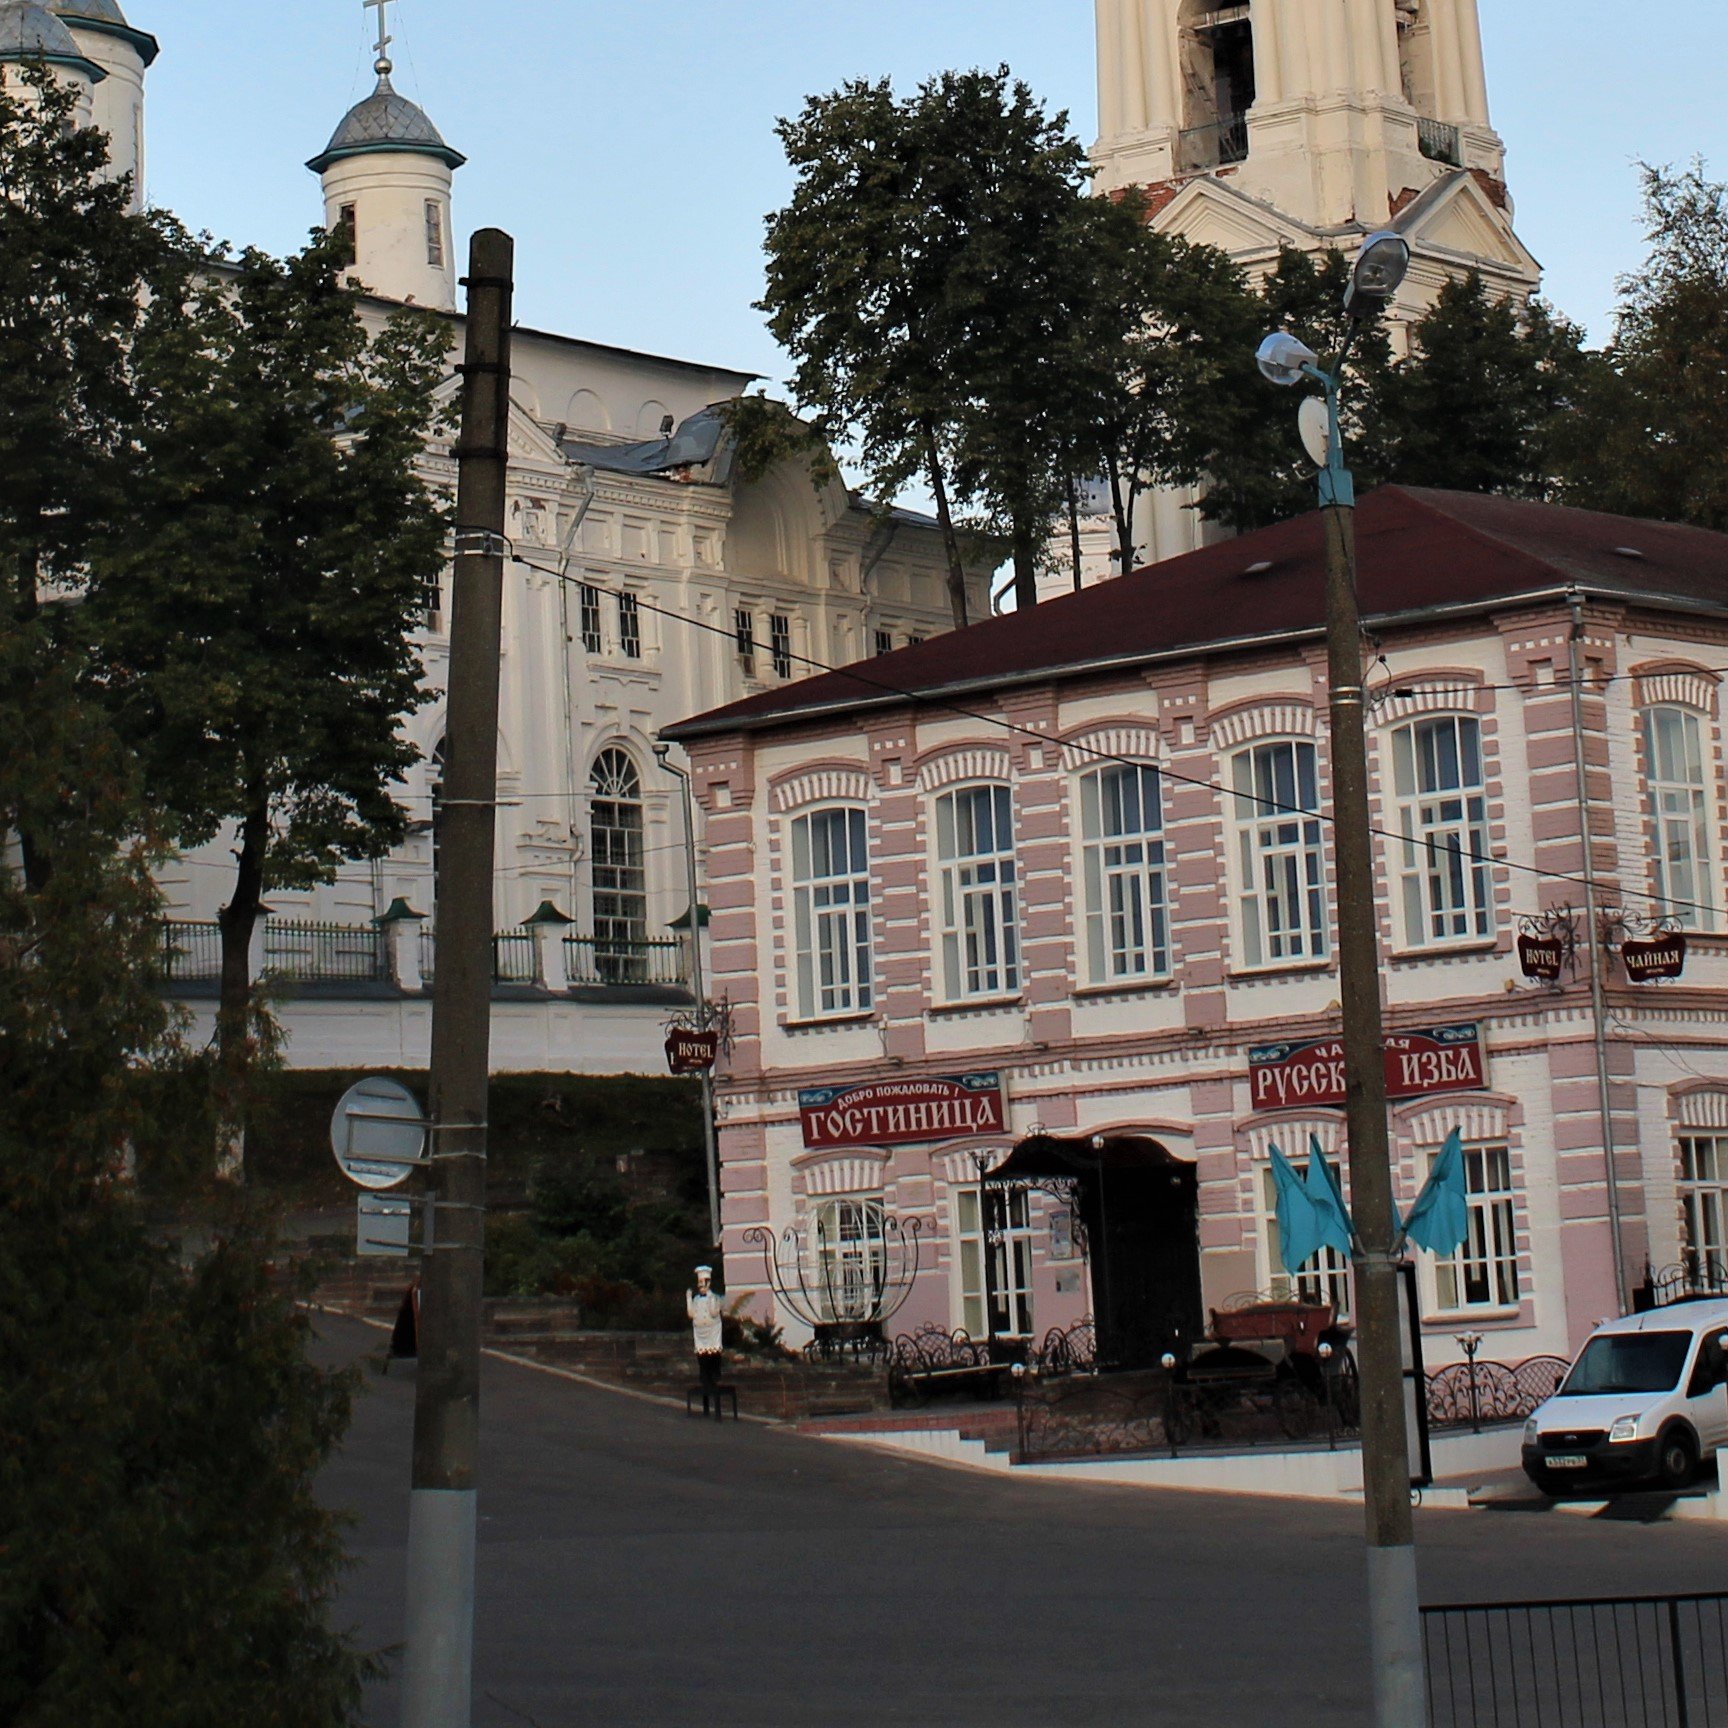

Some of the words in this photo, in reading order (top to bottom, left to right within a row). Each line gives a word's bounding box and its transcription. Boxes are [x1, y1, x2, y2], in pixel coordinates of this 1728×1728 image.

[1525, 948, 1559, 966] HOTEL
[1626, 949, 1680, 968] ЧАЙНАЯ
[678, 1042, 713, 1058] HOTEL
[1314, 1037, 1410, 1057] ЧААЯ
[1256, 1060, 1346, 1104] РУССК
[1399, 1047, 1477, 1087] ИЗБА
[838, 1088, 874, 1110] ДОБРО
[876, 1082, 950, 1098] ПОЖАЛОВАТЬ
[809, 1096, 997, 1140] ГОСТИНИЦА
